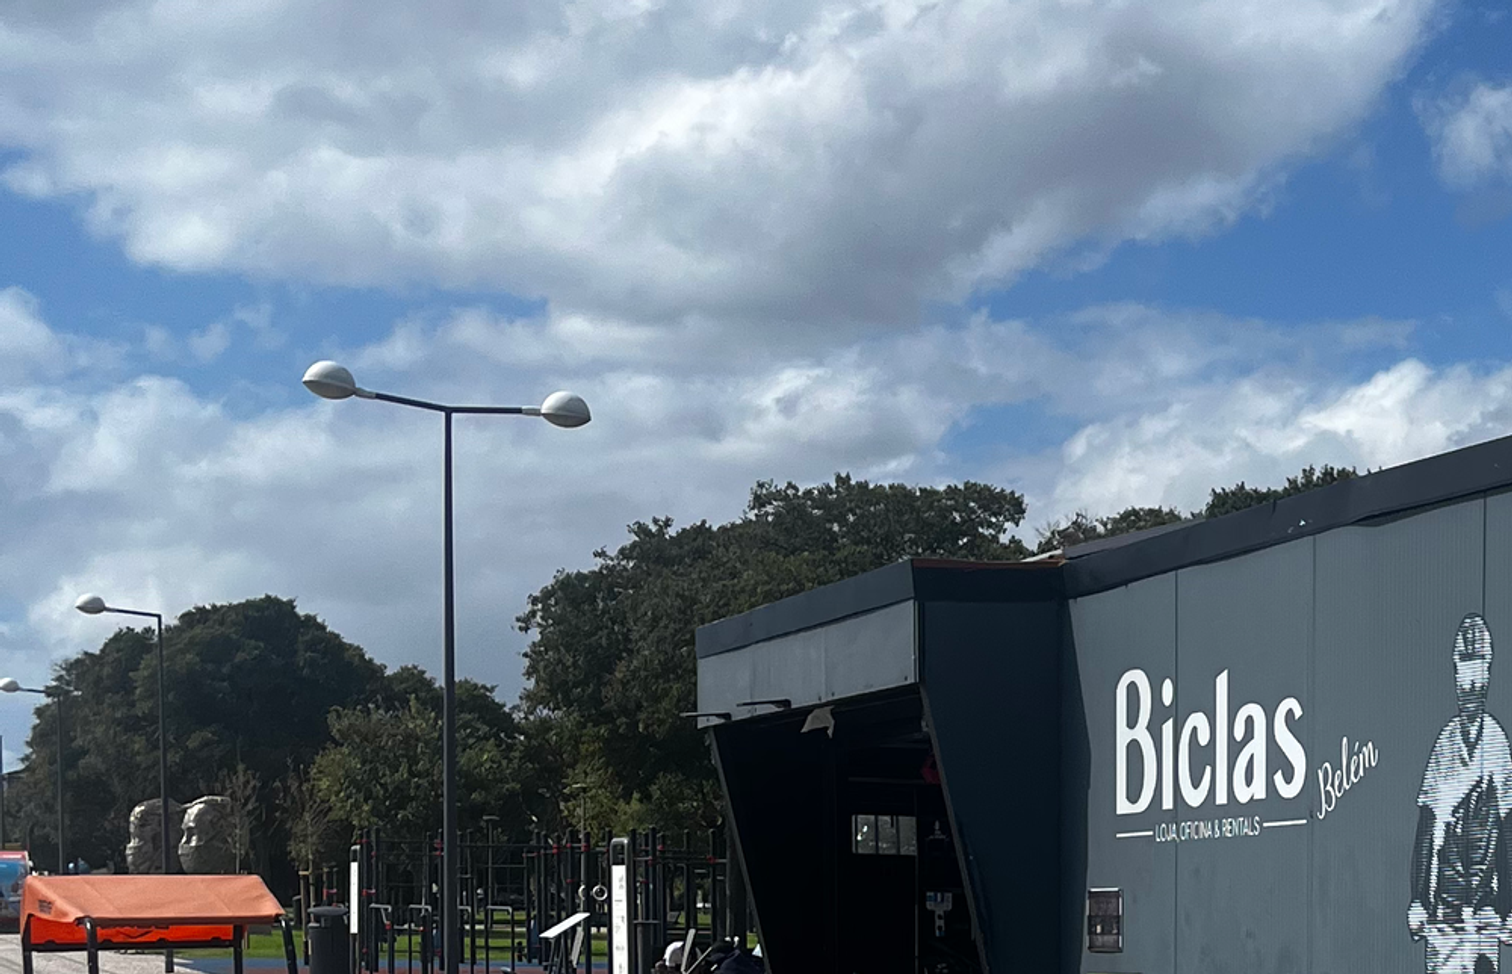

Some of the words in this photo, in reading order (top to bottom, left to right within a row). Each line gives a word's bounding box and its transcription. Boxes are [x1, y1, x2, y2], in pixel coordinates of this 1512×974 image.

[1115, 668, 1307, 815] Biclas
[1316, 736, 1379, 820] Belém
[1180, 821, 1213, 841] OFICINA
[1214, 819, 1220, 839] &
[1221, 815, 1261, 838] RENTALS
